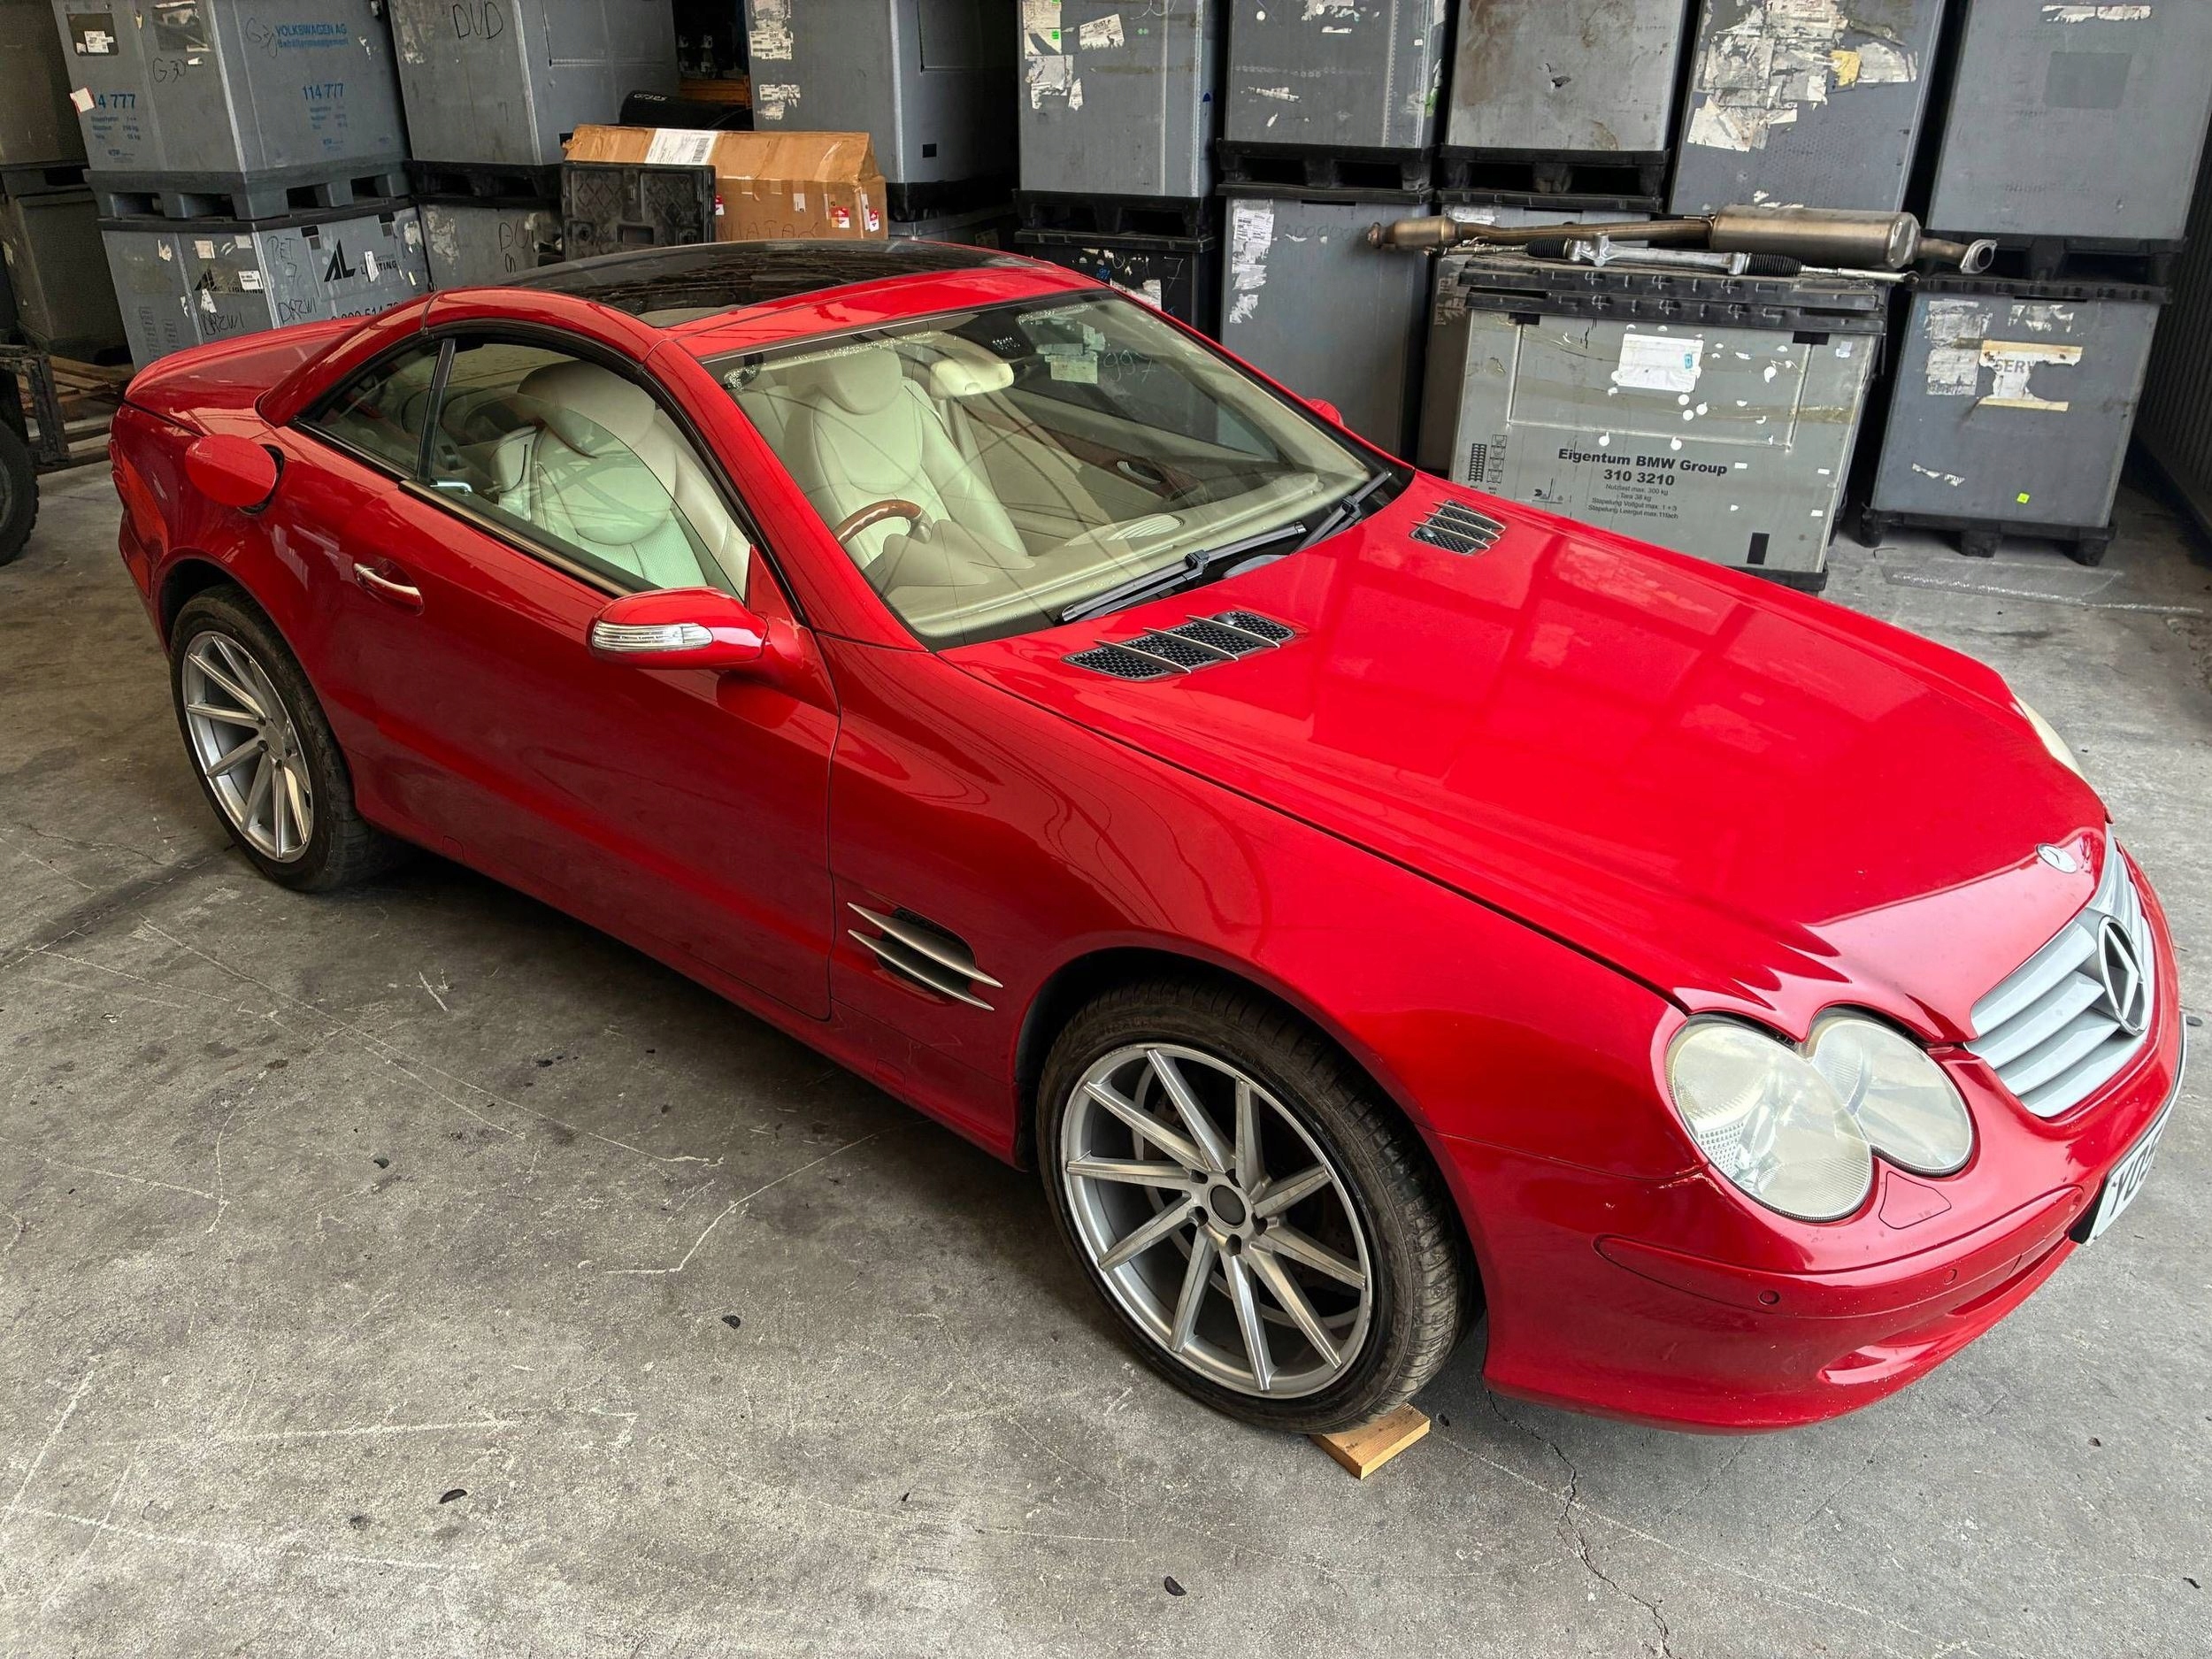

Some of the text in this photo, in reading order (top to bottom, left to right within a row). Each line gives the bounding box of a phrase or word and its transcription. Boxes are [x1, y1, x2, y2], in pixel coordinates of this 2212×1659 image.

[275, 23, 347, 36] VOLKSWAGEN AG
[303, 82, 344, 100] 114 777
[110, 94, 136, 109] 777
[360, 260, 397, 274] LTING
[1558, 448, 1728, 476] Eigentum BMW Group
[1603, 469, 1676, 487] 310 3210
